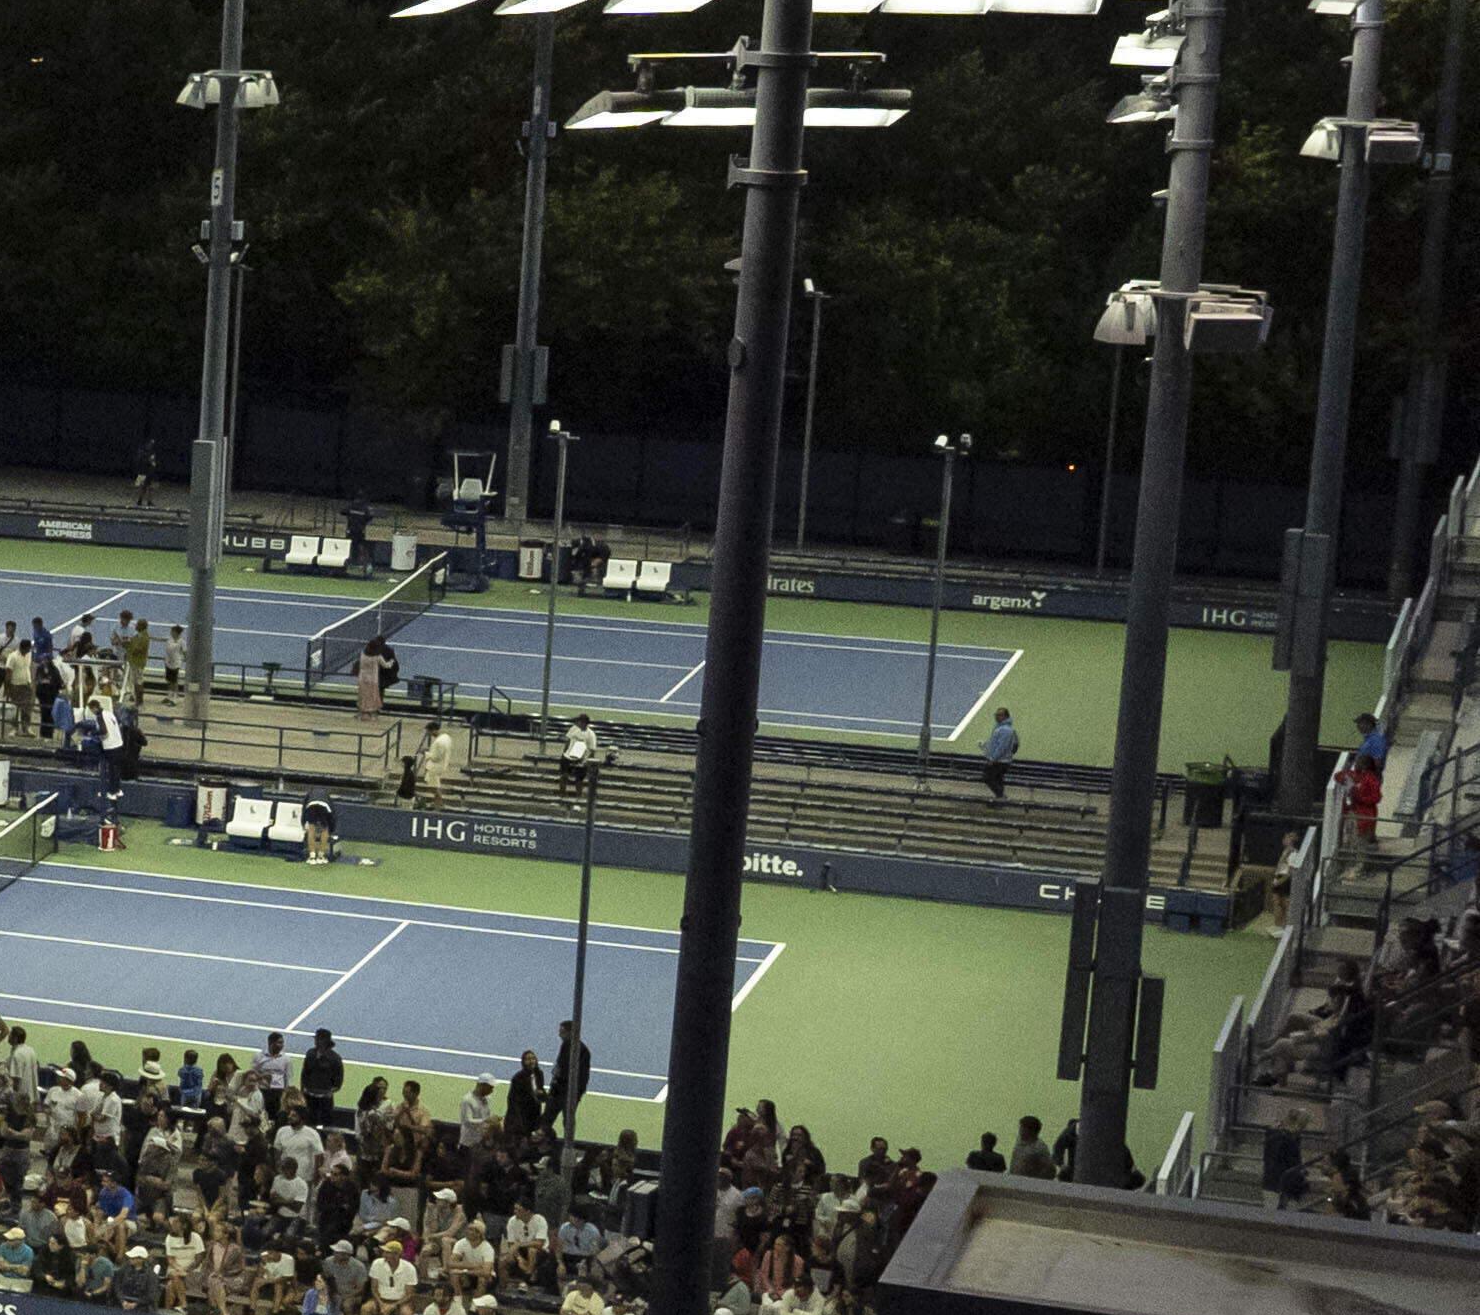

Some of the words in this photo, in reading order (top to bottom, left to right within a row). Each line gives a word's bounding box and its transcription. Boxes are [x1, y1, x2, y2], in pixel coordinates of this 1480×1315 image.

[767, 574, 815, 593] irates
[972, 593, 1032, 610] argenx
[1203, 607, 1247, 626] IHG
[412, 816, 467, 843] IHG
[473, 823, 526, 837] HOTELS
[473, 834, 538, 850] RESORTS
